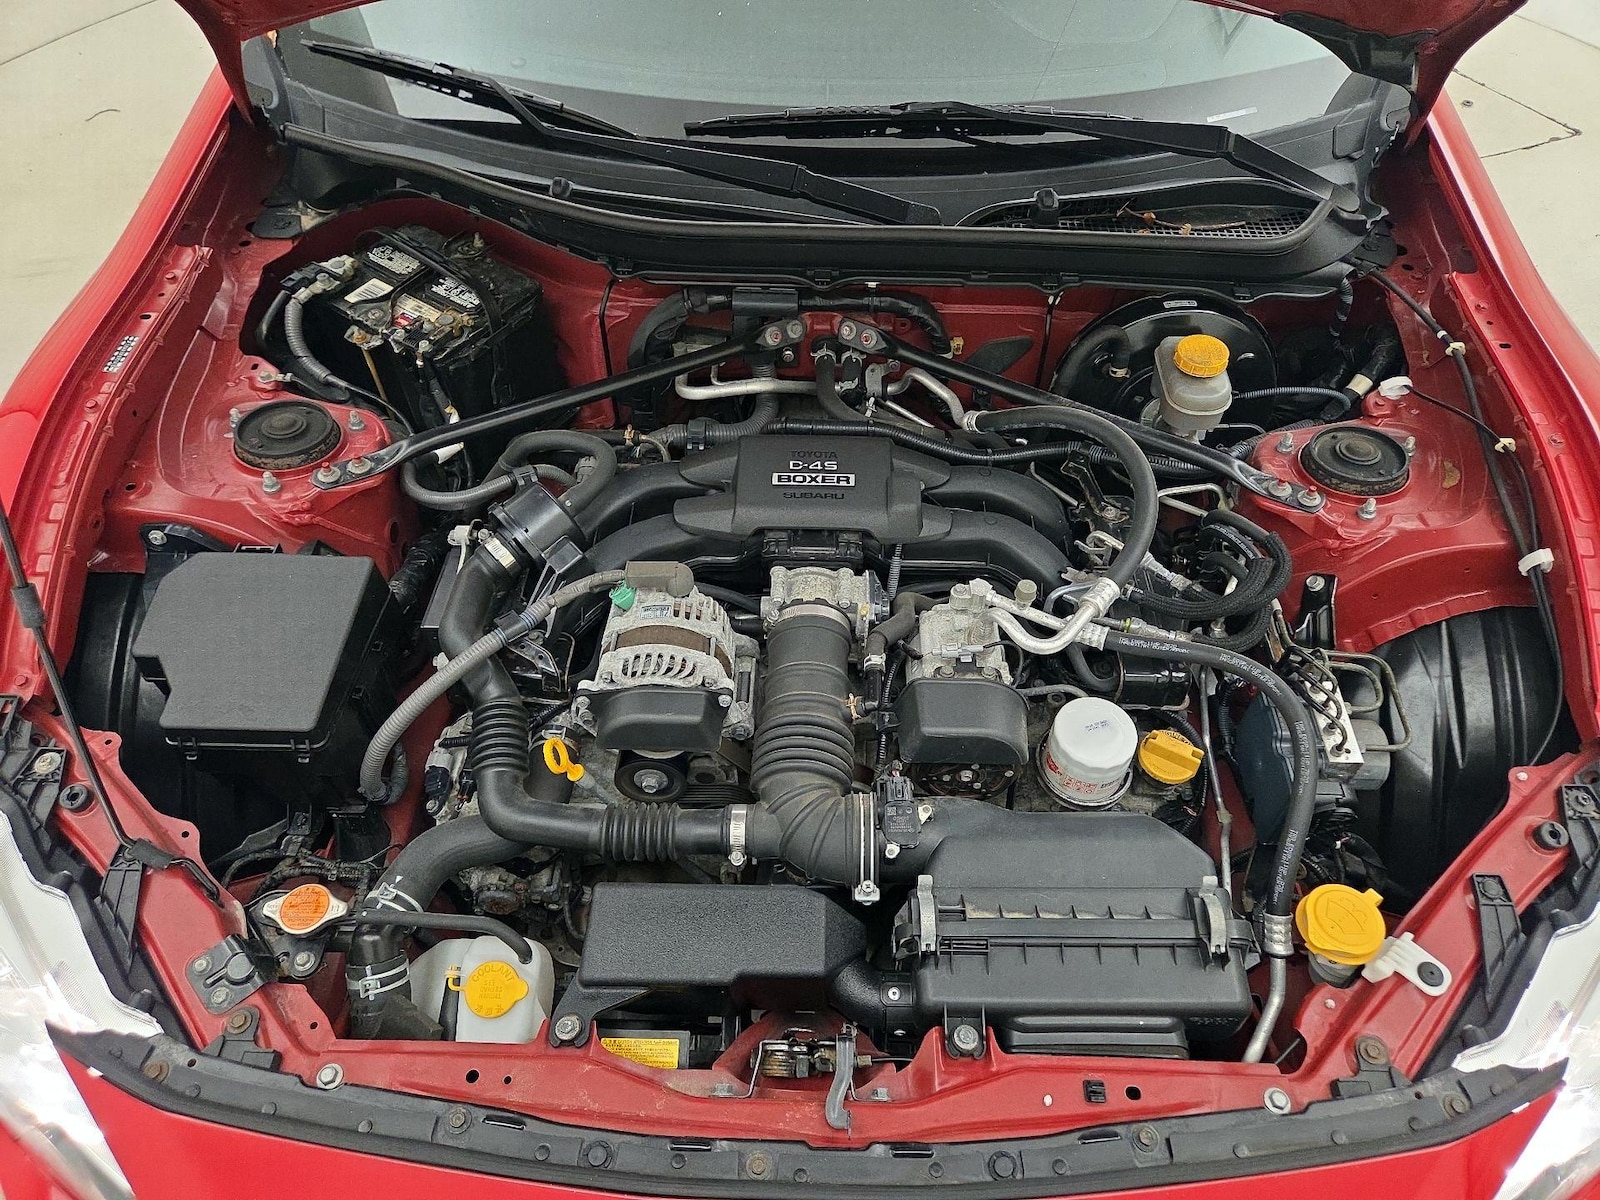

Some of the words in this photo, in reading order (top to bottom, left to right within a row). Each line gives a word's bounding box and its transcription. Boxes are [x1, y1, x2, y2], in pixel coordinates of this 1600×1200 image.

[790, 450, 838, 459] TOYOTA
[789, 460, 838, 471] D-4S
[777, 474, 851, 484] BOXER
[783, 492, 845, 500] SUBARU
[472, 964, 514, 982] COOLANT
